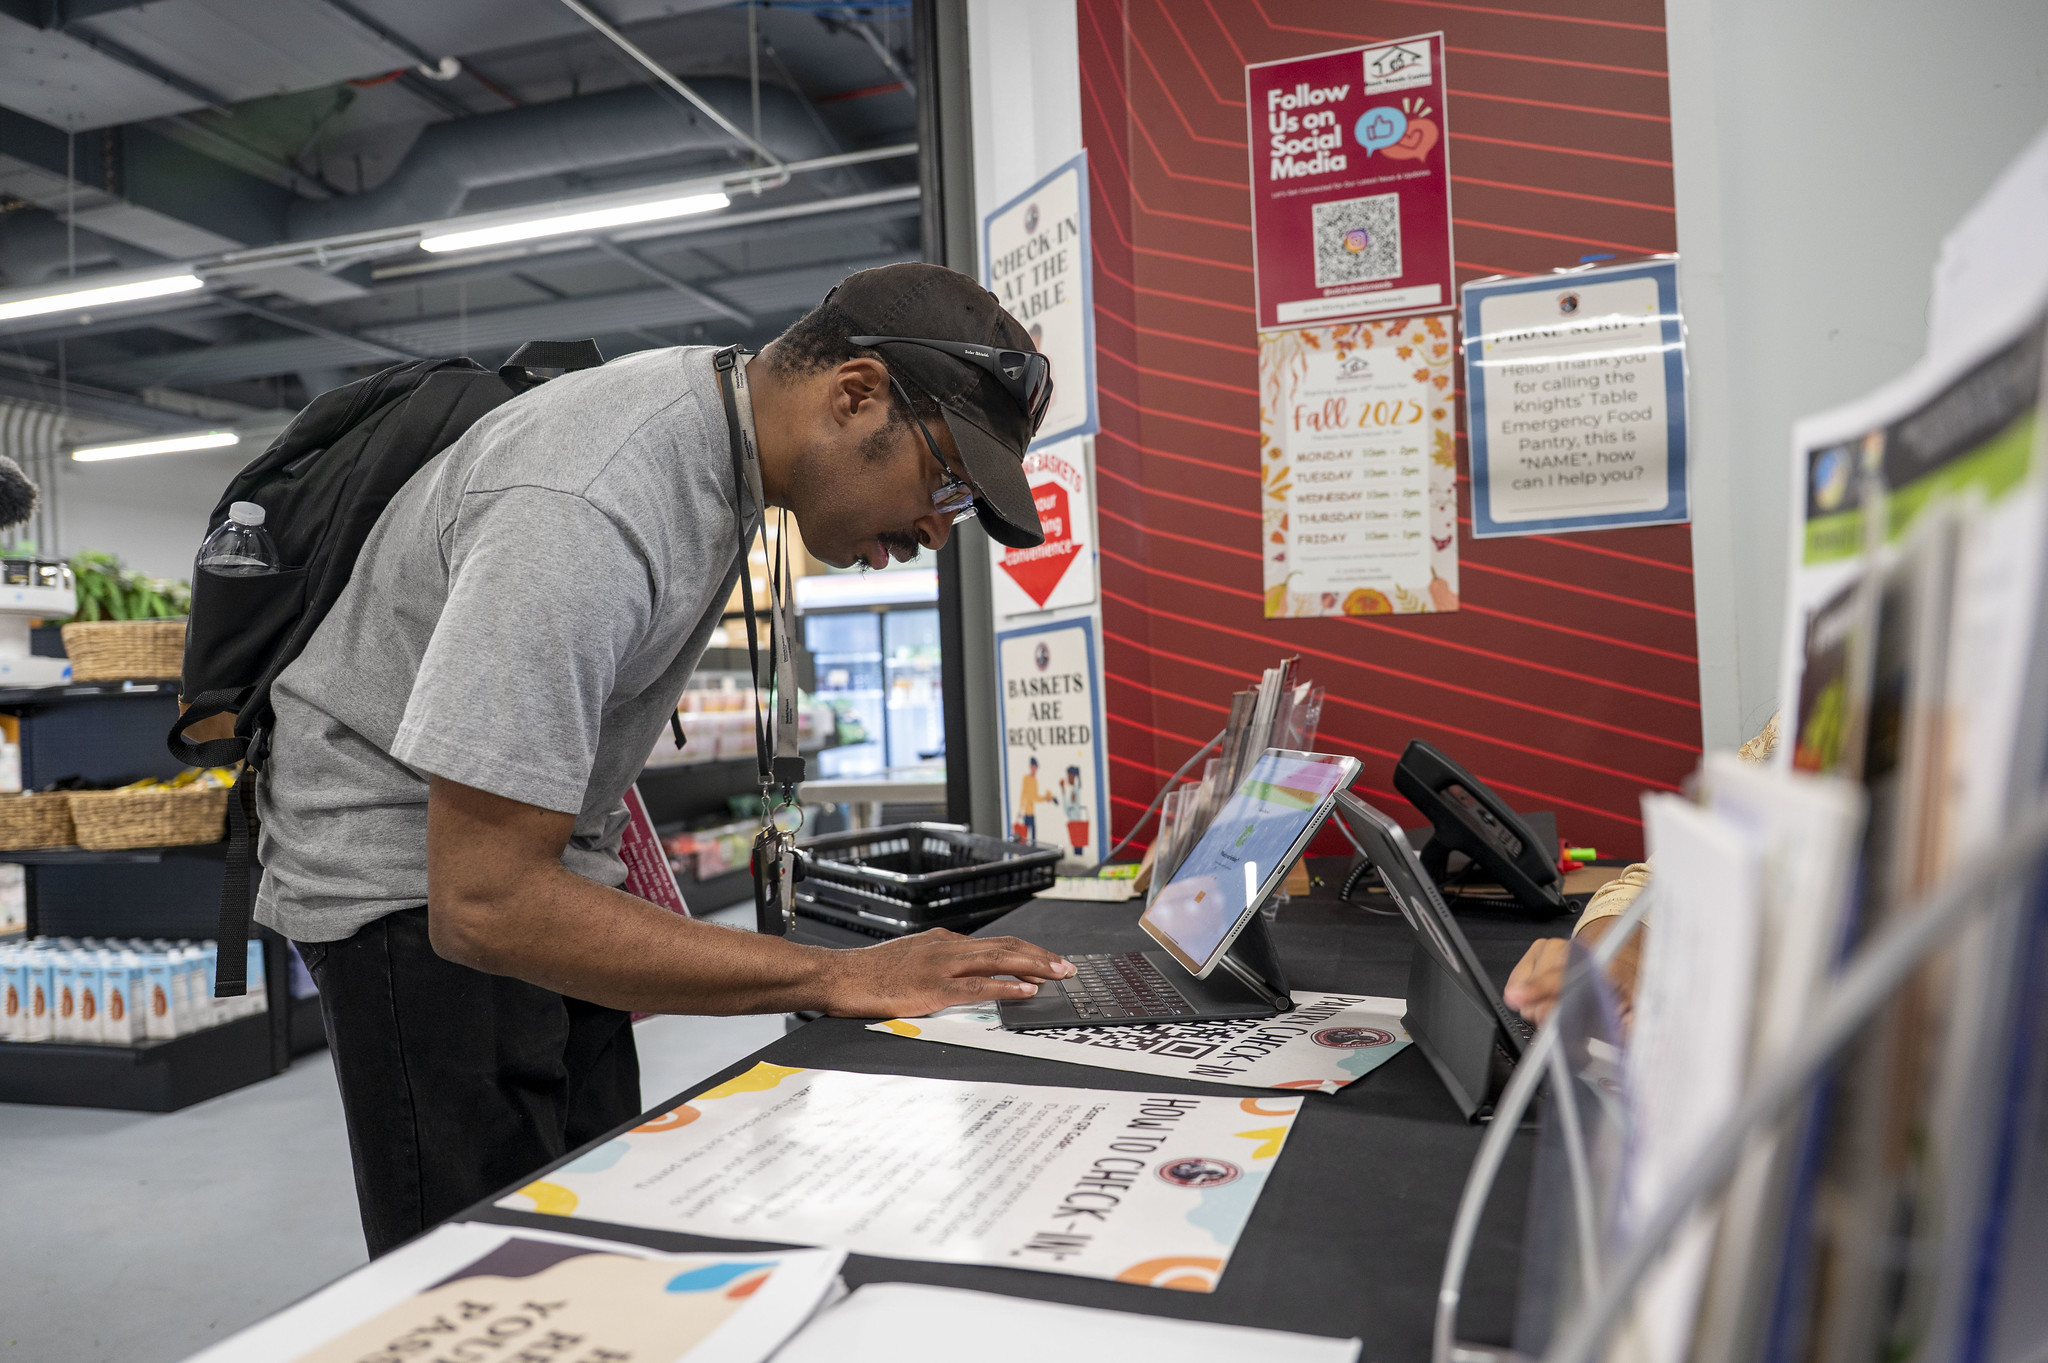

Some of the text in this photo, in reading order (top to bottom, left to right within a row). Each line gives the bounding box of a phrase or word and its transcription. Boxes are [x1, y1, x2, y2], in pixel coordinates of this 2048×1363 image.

[1267, 82, 1350, 113] Follow
[1268, 109, 1335, 135] Us on
[1270, 125, 1342, 158] Social
[1270, 152, 1347, 181] Media
[1002, 249, 1069, 302] AT THE
[1501, 353, 1647, 377] Hello! Thank you
[1514, 369, 1636, 394] for calling the
[1513, 388, 1639, 414] Knights' Table
[1294, 397, 1424, 432] Fall 2025
[1501, 406, 1653, 435] Emergency Food
[1585, 428, 1618, 445] this
[1622, 428, 1637, 443] is
[1297, 449, 1353, 463] MONDAY
[1596, 447, 1637, 465] how
[1296, 470, 1353, 484] TUESDAY
[1511, 475, 1545, 491] can
[1557, 467, 1598, 487] help
[1600, 464, 1645, 485] you?
[1034, 494, 1058, 512] our
[1296, 490, 1363, 505] WEDNESDAY
[1297, 512, 1363, 525] THURSDAY
[1297, 532, 1347, 545] FRIDAY
[1005, 539, 1074, 566] convenience
[1008, 673, 1084, 699] BASKETS
[1029, 700, 1064, 722] ARE
[1008, 723, 1091, 751] REQUIRED
[630, 842, 638, 859] Friday
[631, 821, 641, 843] Monday
[642, 848, 653, 872] Thursday
[648, 838, 659, 862] Welcome
[658, 863, 666, 880] Center
[1280, 996, 1366, 1026] PANTRY
[1126, 1097, 1200, 1131] HOW
[1109, 1136, 1168, 1154] TO
